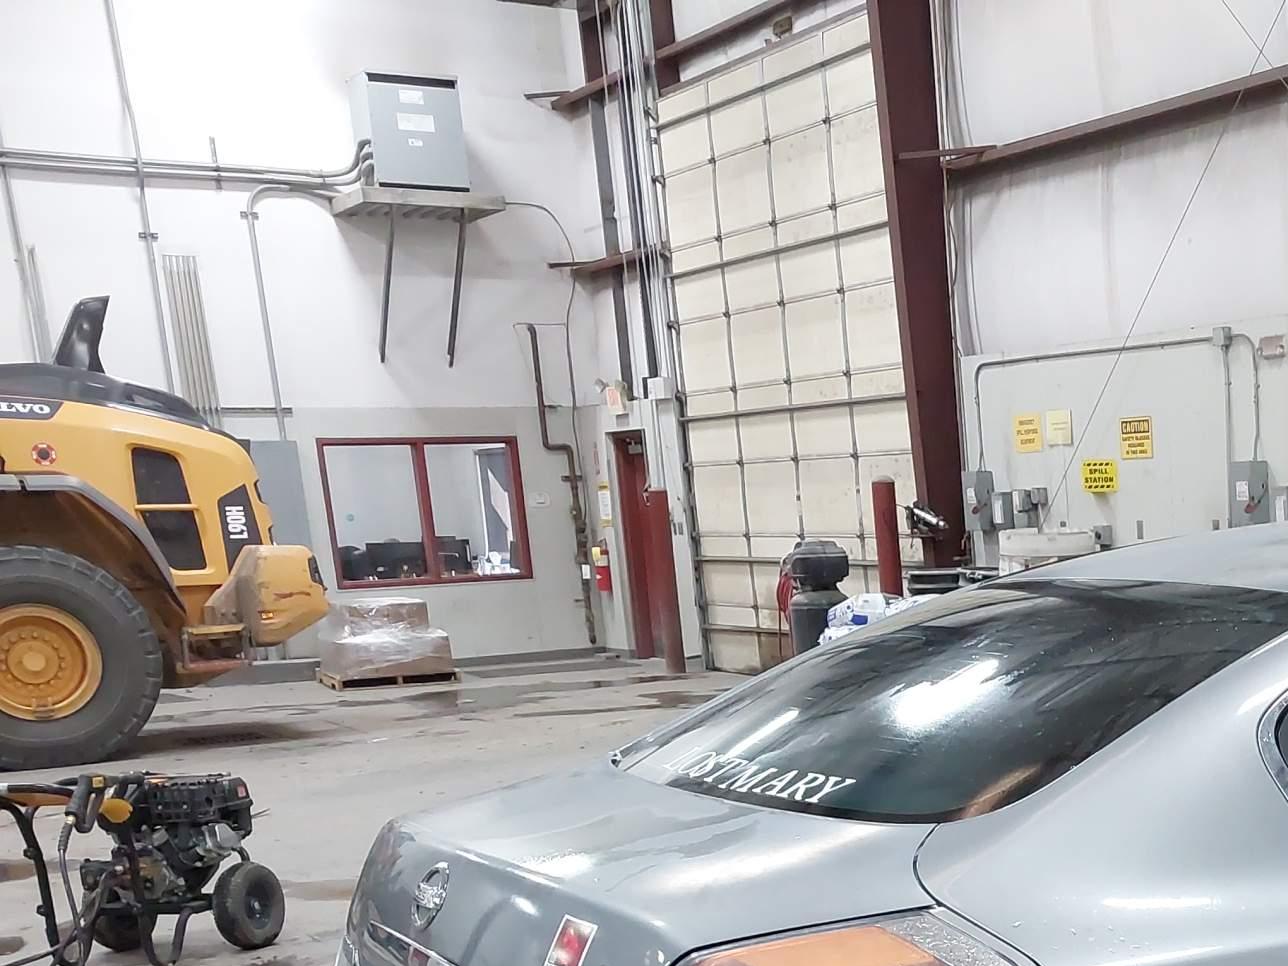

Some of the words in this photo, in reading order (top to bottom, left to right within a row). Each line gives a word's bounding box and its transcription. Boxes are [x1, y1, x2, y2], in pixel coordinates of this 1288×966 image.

[1122, 420, 1149, 433] CAUTION
[1084, 476, 1114, 484] STATION
[225, 505, 249, 539] L90H
